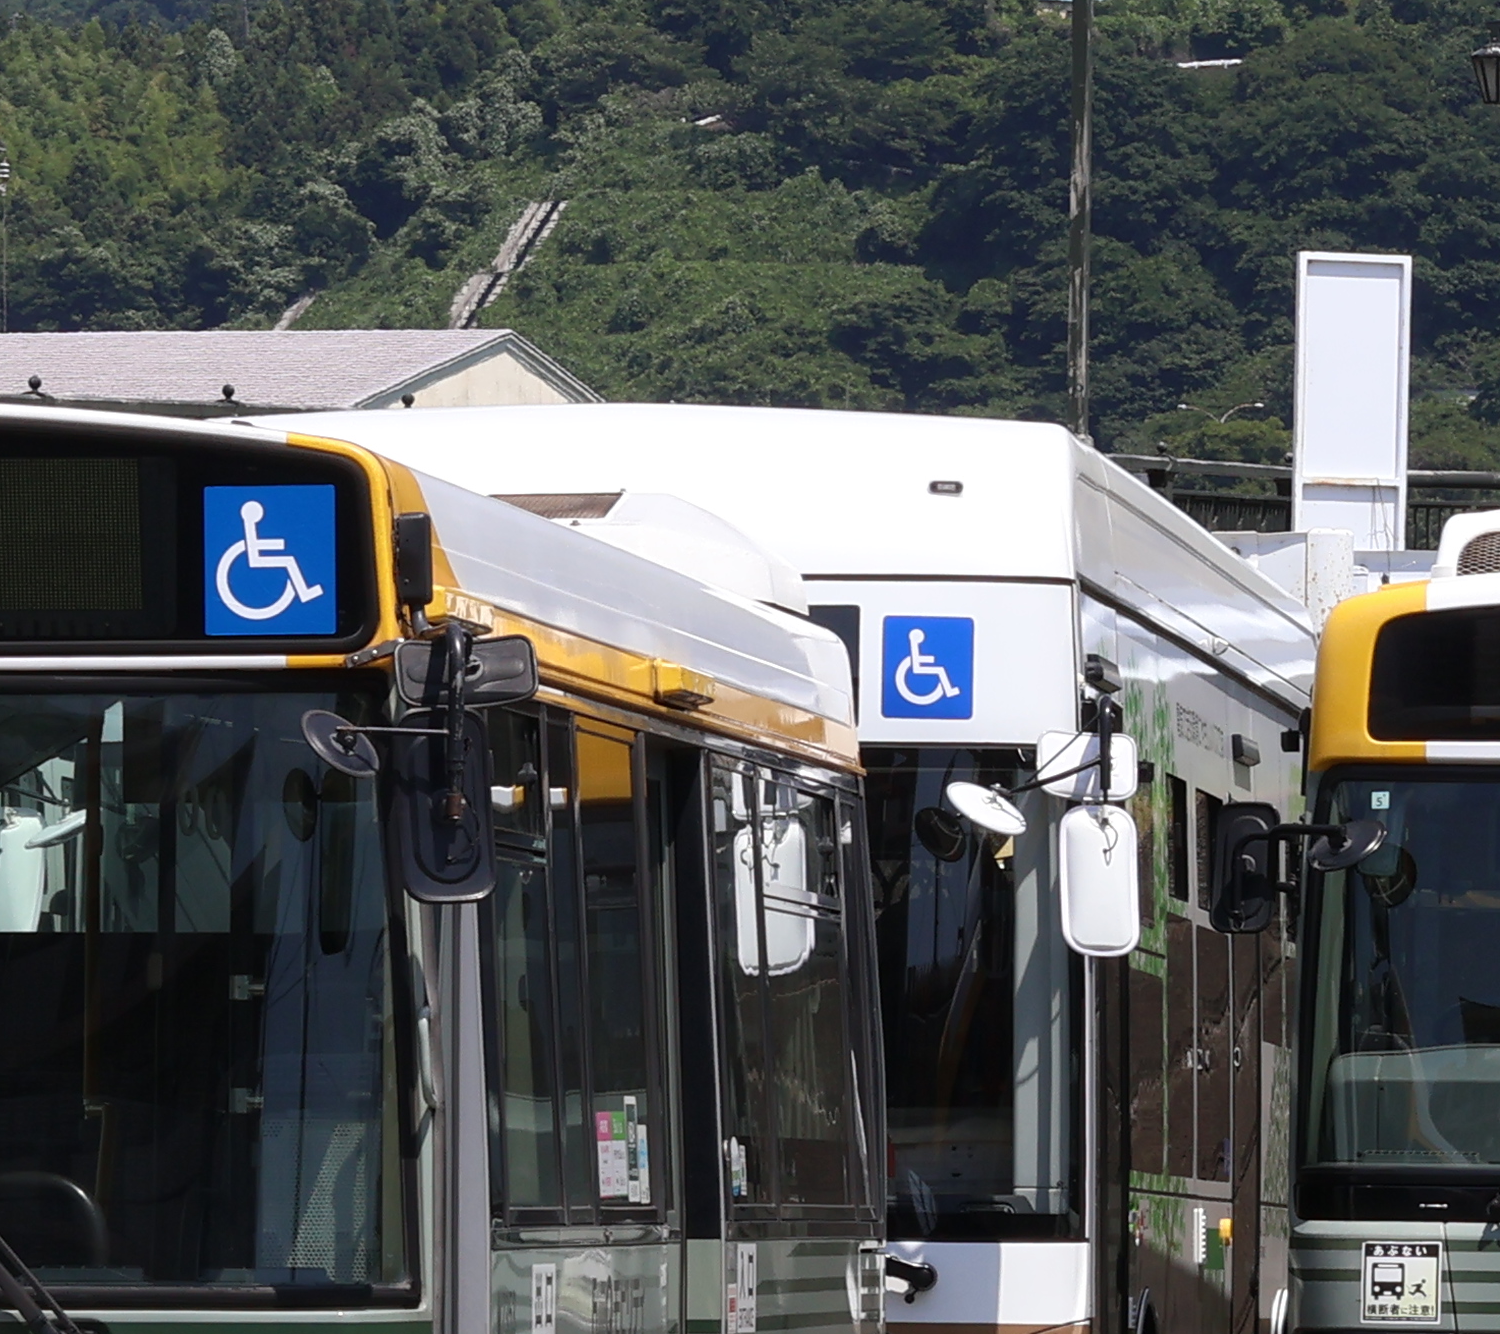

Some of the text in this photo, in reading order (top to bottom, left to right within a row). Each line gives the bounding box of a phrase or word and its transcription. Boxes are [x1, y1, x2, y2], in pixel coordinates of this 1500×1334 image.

[1373, 1245, 1428, 1256] あぶない
[1367, 1304, 1435, 1316] 横断者に注意!
